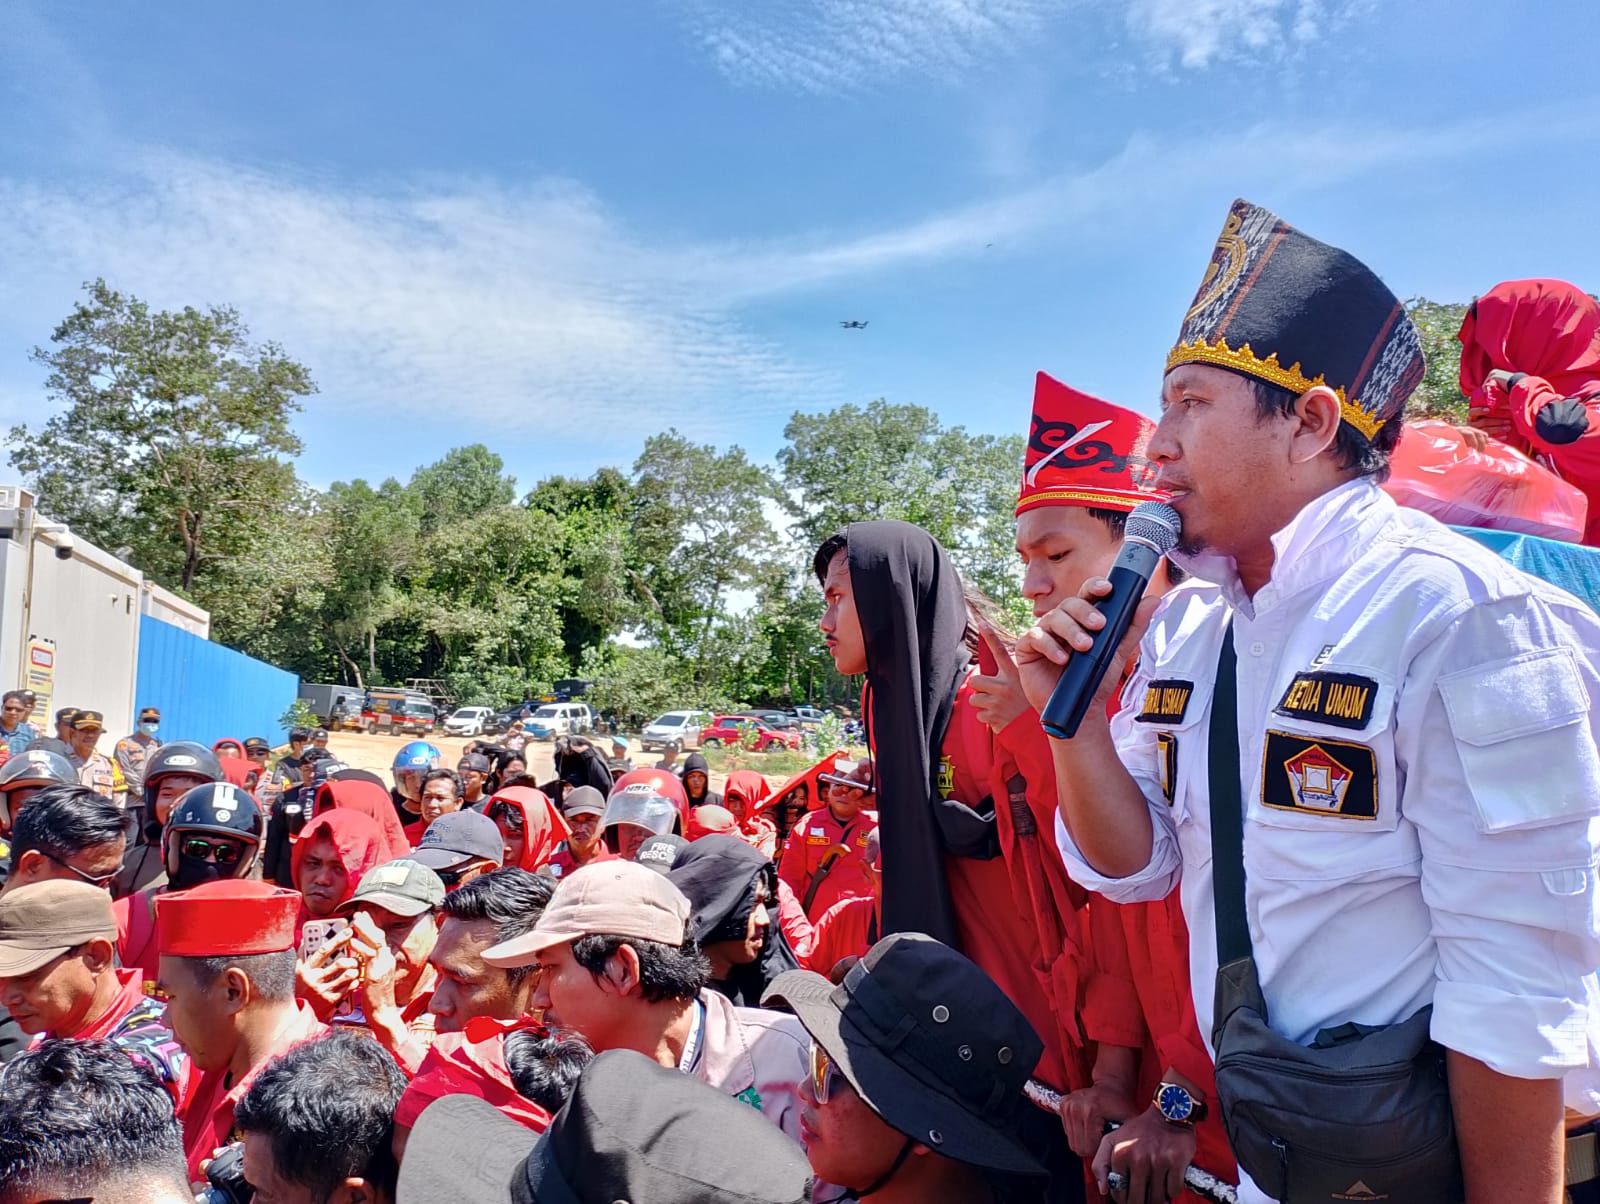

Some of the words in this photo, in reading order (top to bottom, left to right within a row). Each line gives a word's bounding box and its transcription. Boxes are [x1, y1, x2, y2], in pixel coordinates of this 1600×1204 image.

[1284, 680, 1323, 713] KETUA
[1324, 682, 1369, 720] UMUM
[651, 842, 677, 855] FIRE
